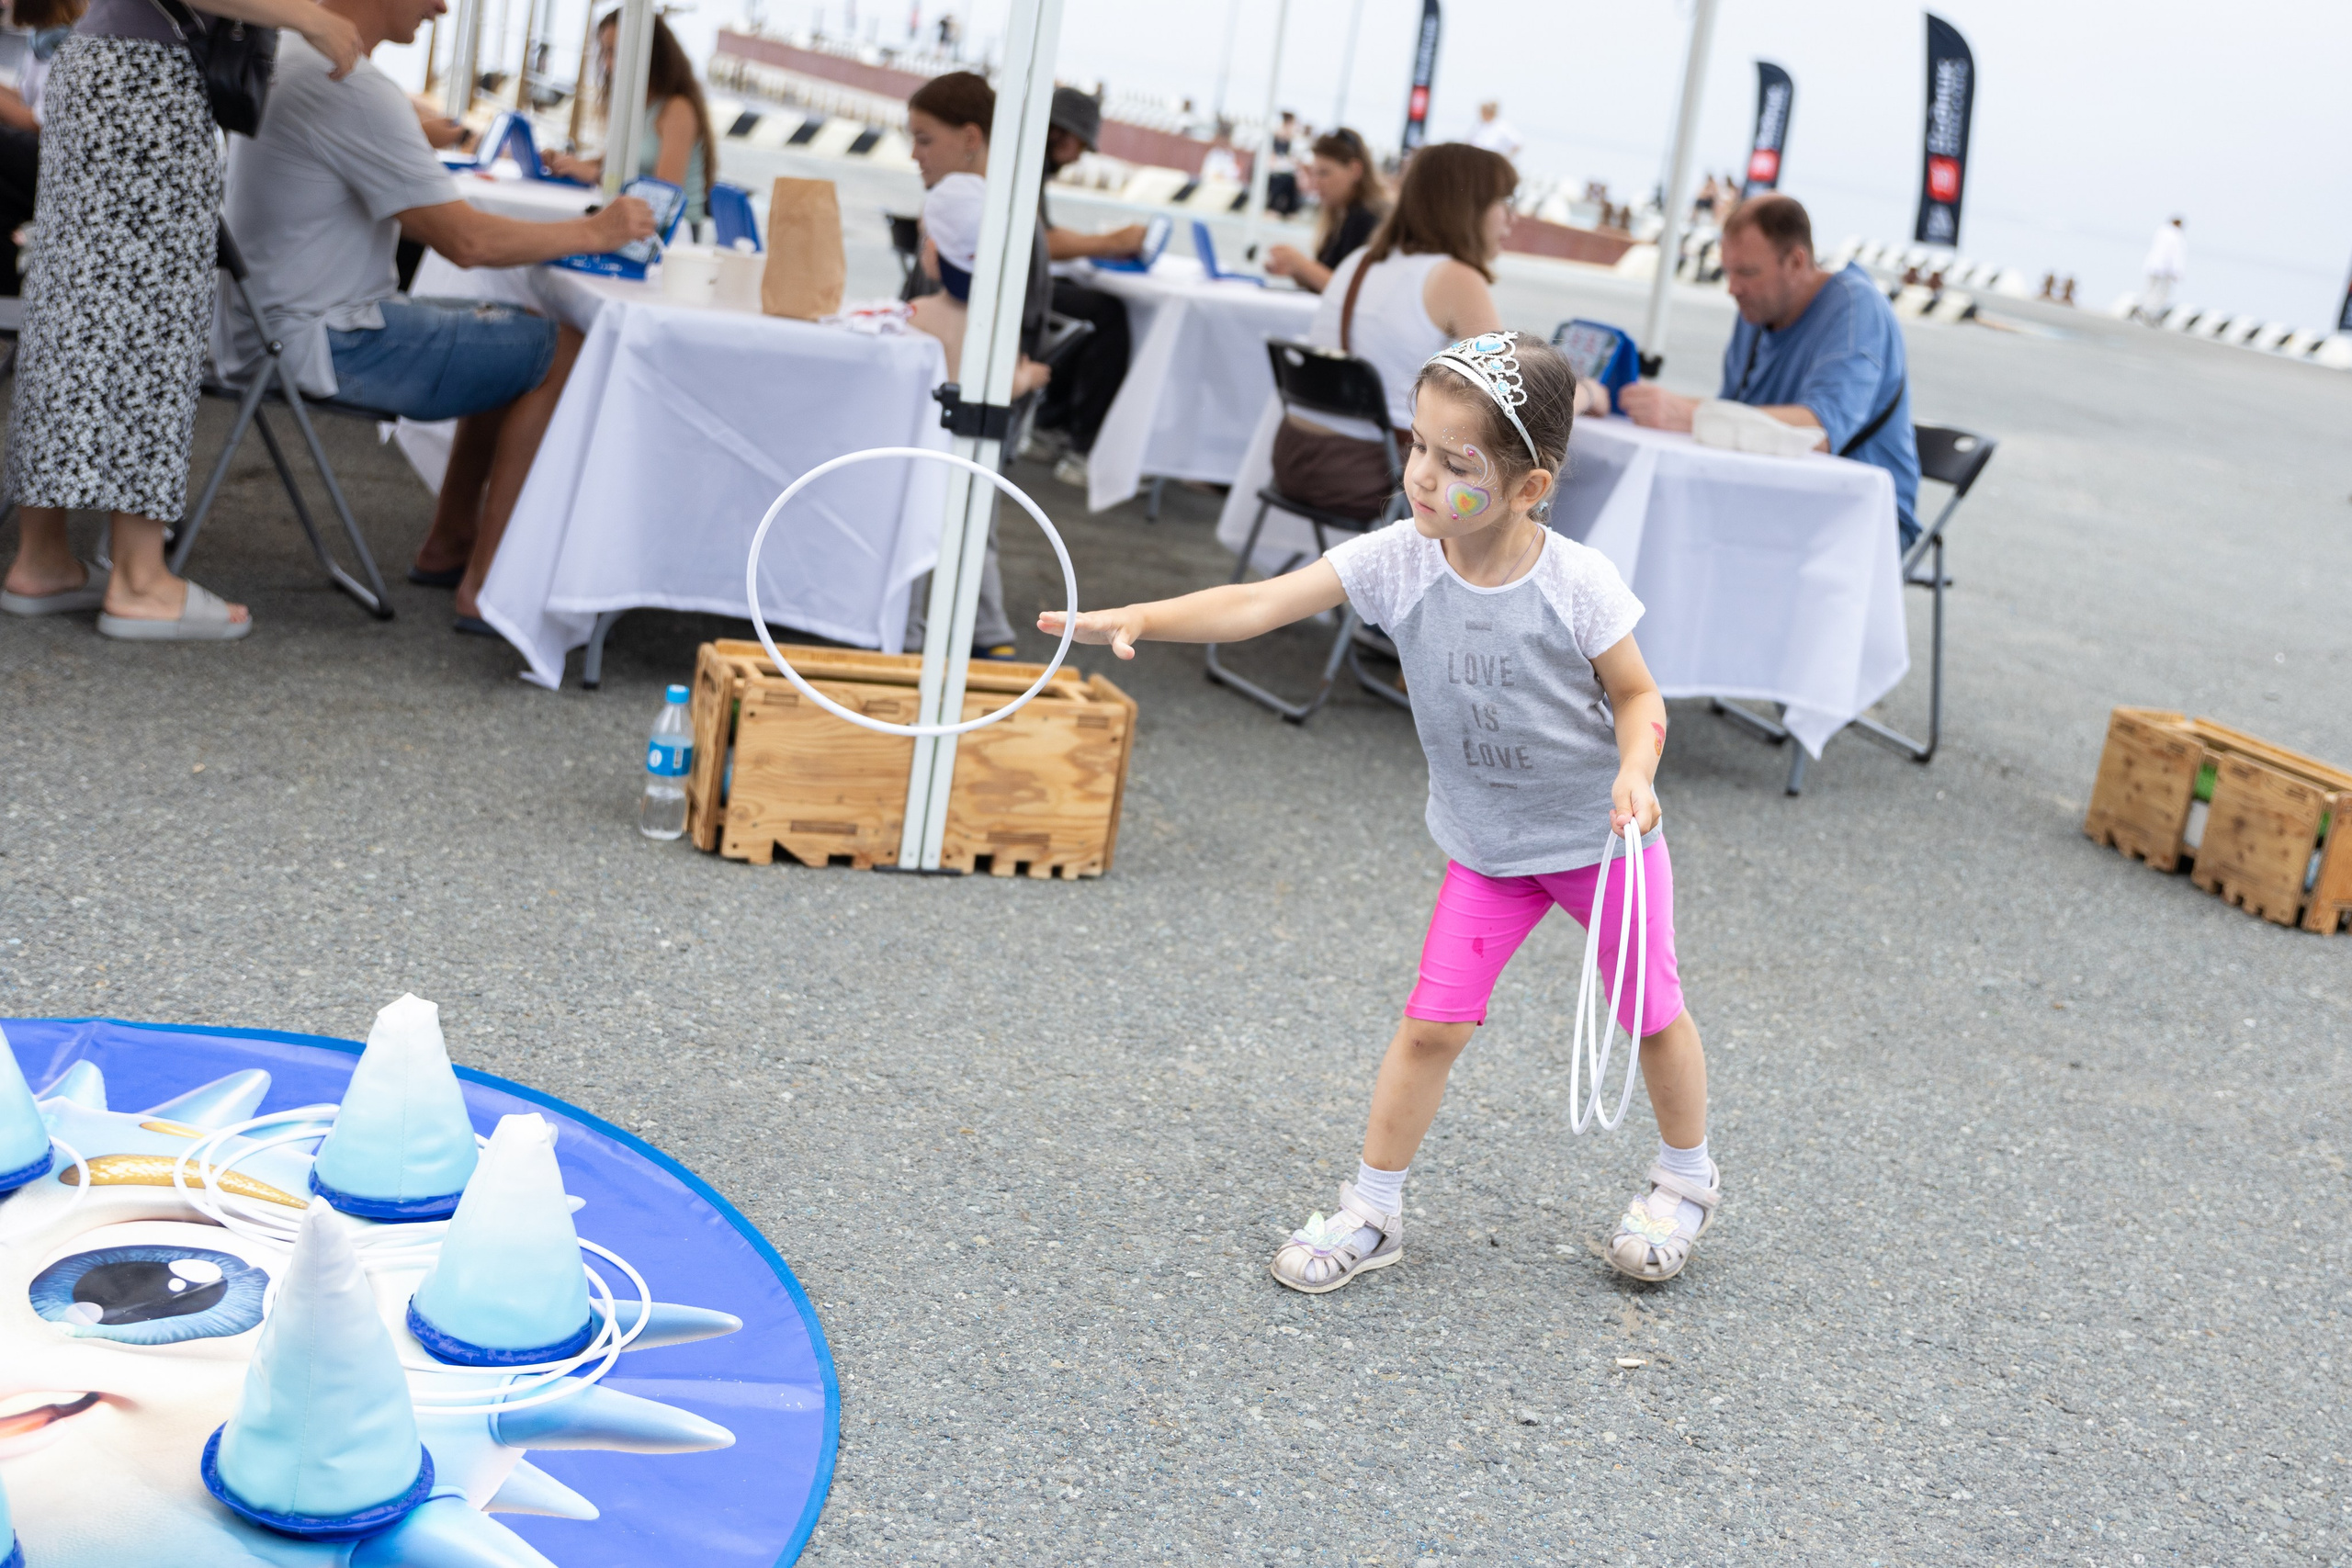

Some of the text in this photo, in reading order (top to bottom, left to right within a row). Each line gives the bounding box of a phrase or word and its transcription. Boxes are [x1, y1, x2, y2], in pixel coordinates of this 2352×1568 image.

[1448, 651, 1515, 687] LOVE
[1472, 702, 1499, 732] IS
[1463, 739, 1533, 770] LOVE
